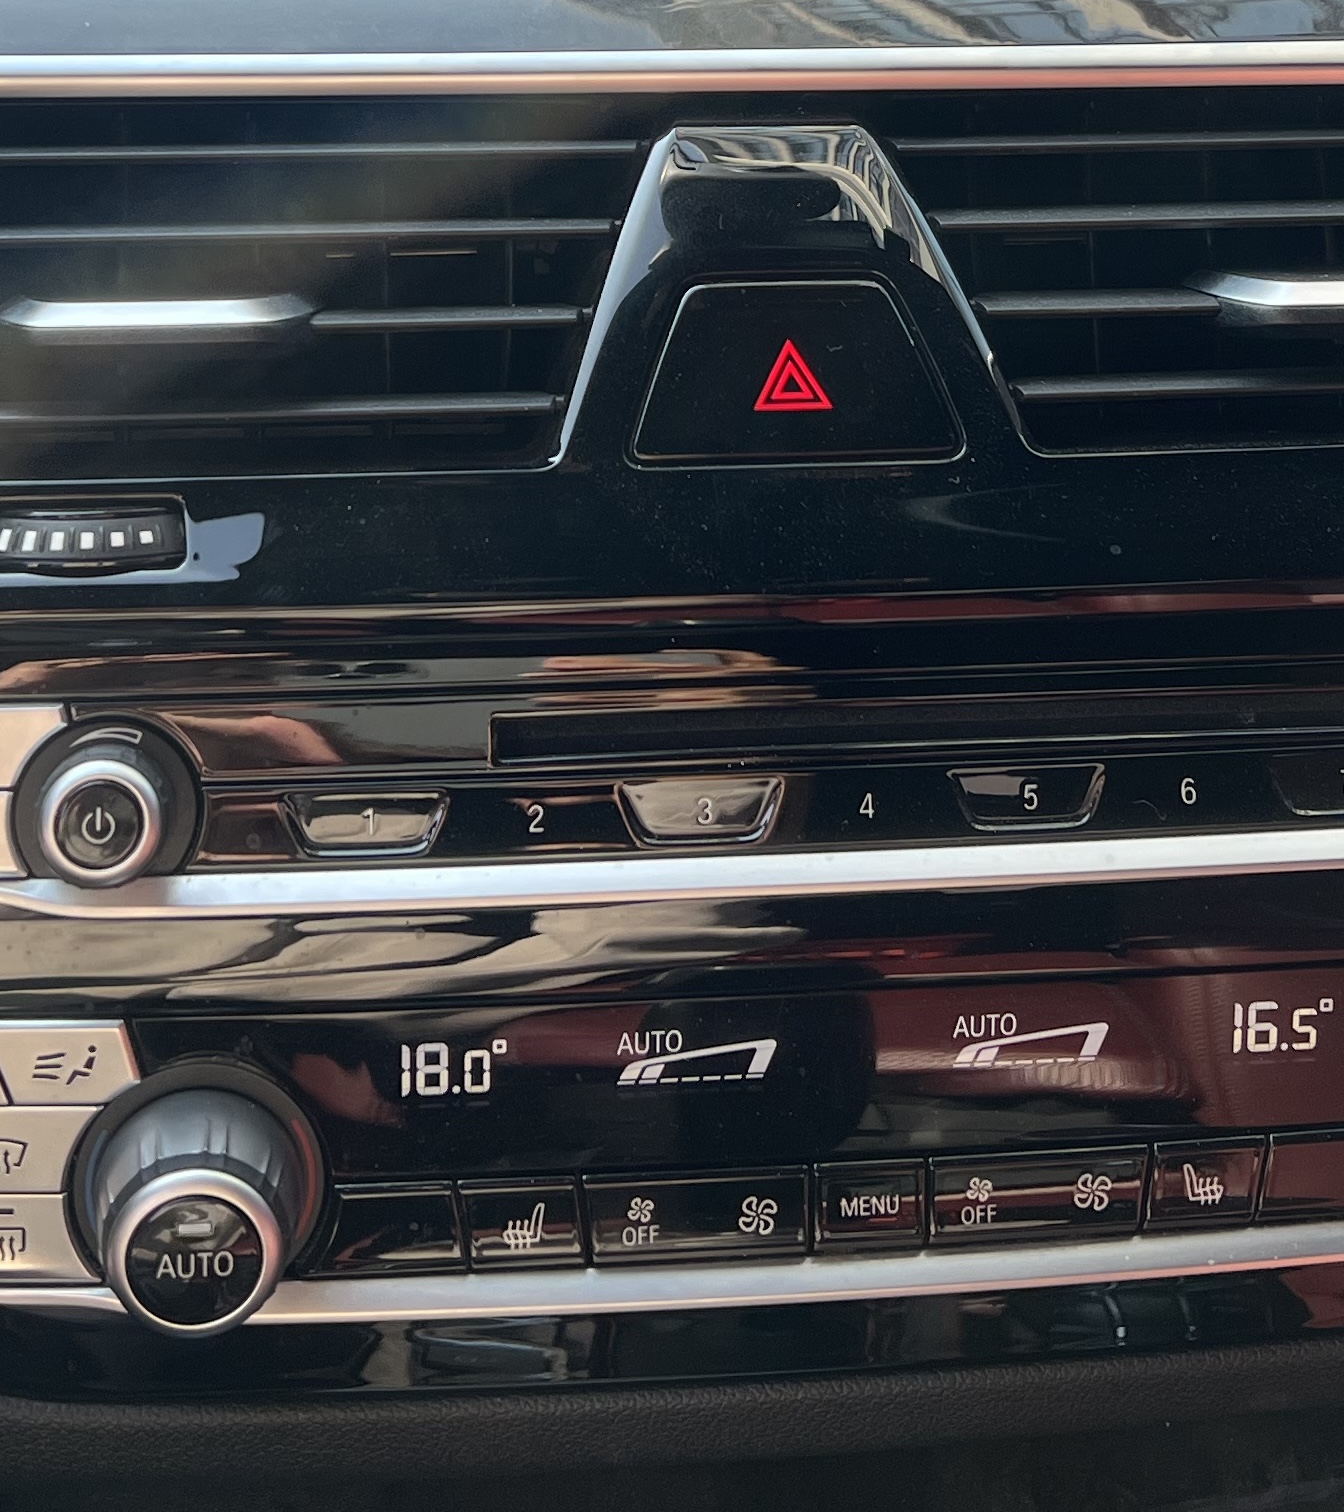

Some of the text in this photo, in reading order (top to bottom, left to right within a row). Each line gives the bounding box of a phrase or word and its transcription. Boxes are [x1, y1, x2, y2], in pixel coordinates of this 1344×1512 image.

[361, 806, 375, 835] 1
[528, 804, 545, 833] 2
[697, 797, 714, 824] 3
[859, 793, 875, 819] 4
[1022, 782, 1039, 811] 5
[1179, 777, 1197, 805] 6
[952, 1012, 1017, 1039] AUTO
[617, 1029, 684, 1055] AUTO
[840, 1194, 900, 1217] MENU
[960, 1204, 998, 1226] OFF
[621, 1225, 661, 1247] OFF
[156, 1252, 234, 1280] AUTO
